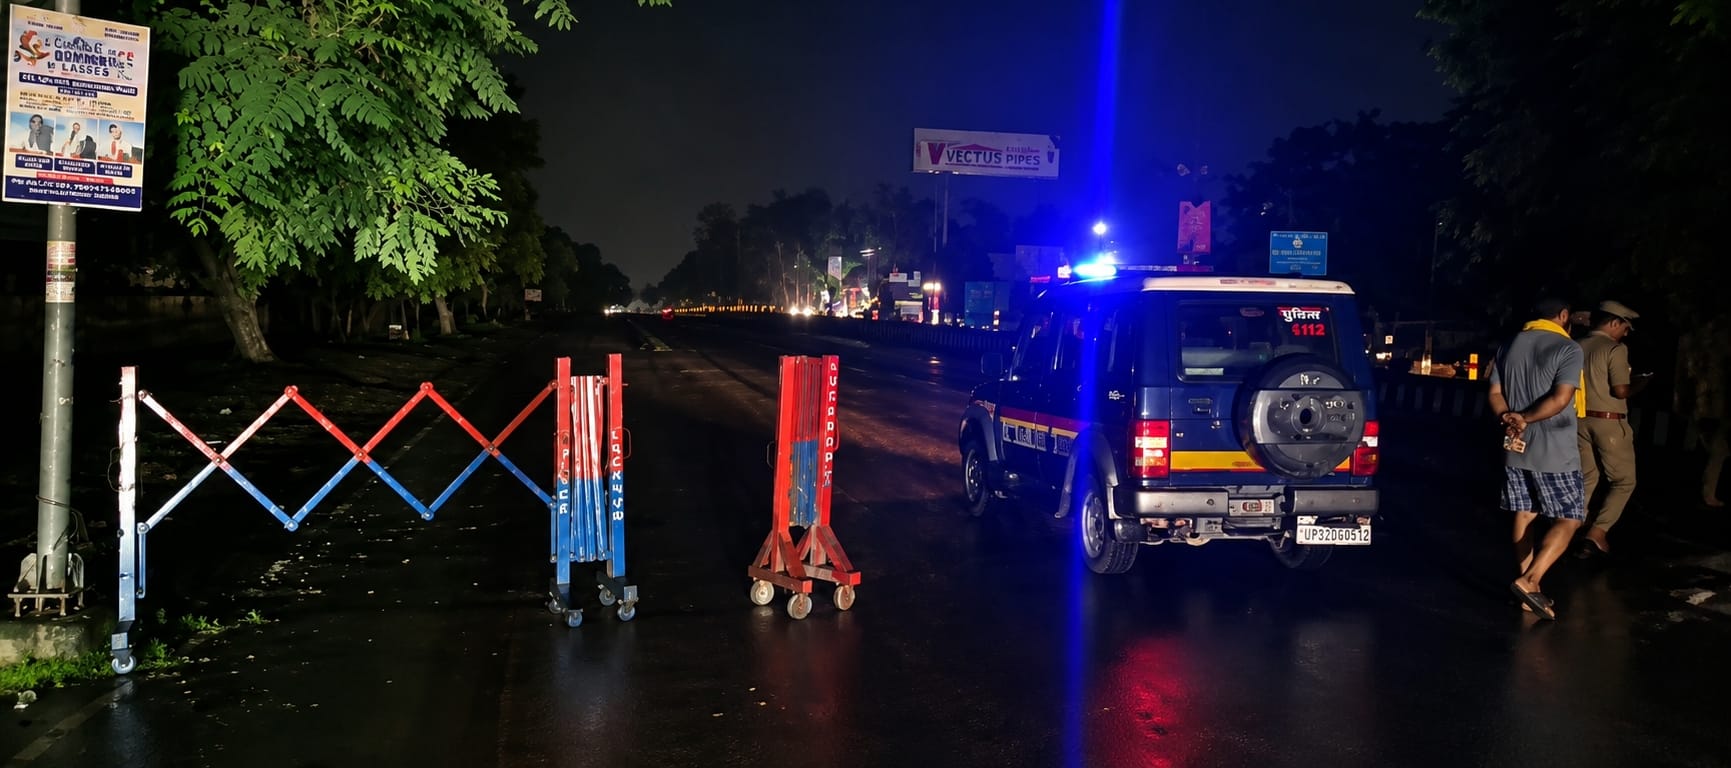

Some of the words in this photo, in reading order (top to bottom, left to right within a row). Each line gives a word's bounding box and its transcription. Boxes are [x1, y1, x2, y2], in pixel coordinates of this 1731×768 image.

[946, 150, 1002, 164] VECTUS
[1006, 154, 1040, 166] PIPES
[1304, 528, 1369, 541] UP32DG0512
